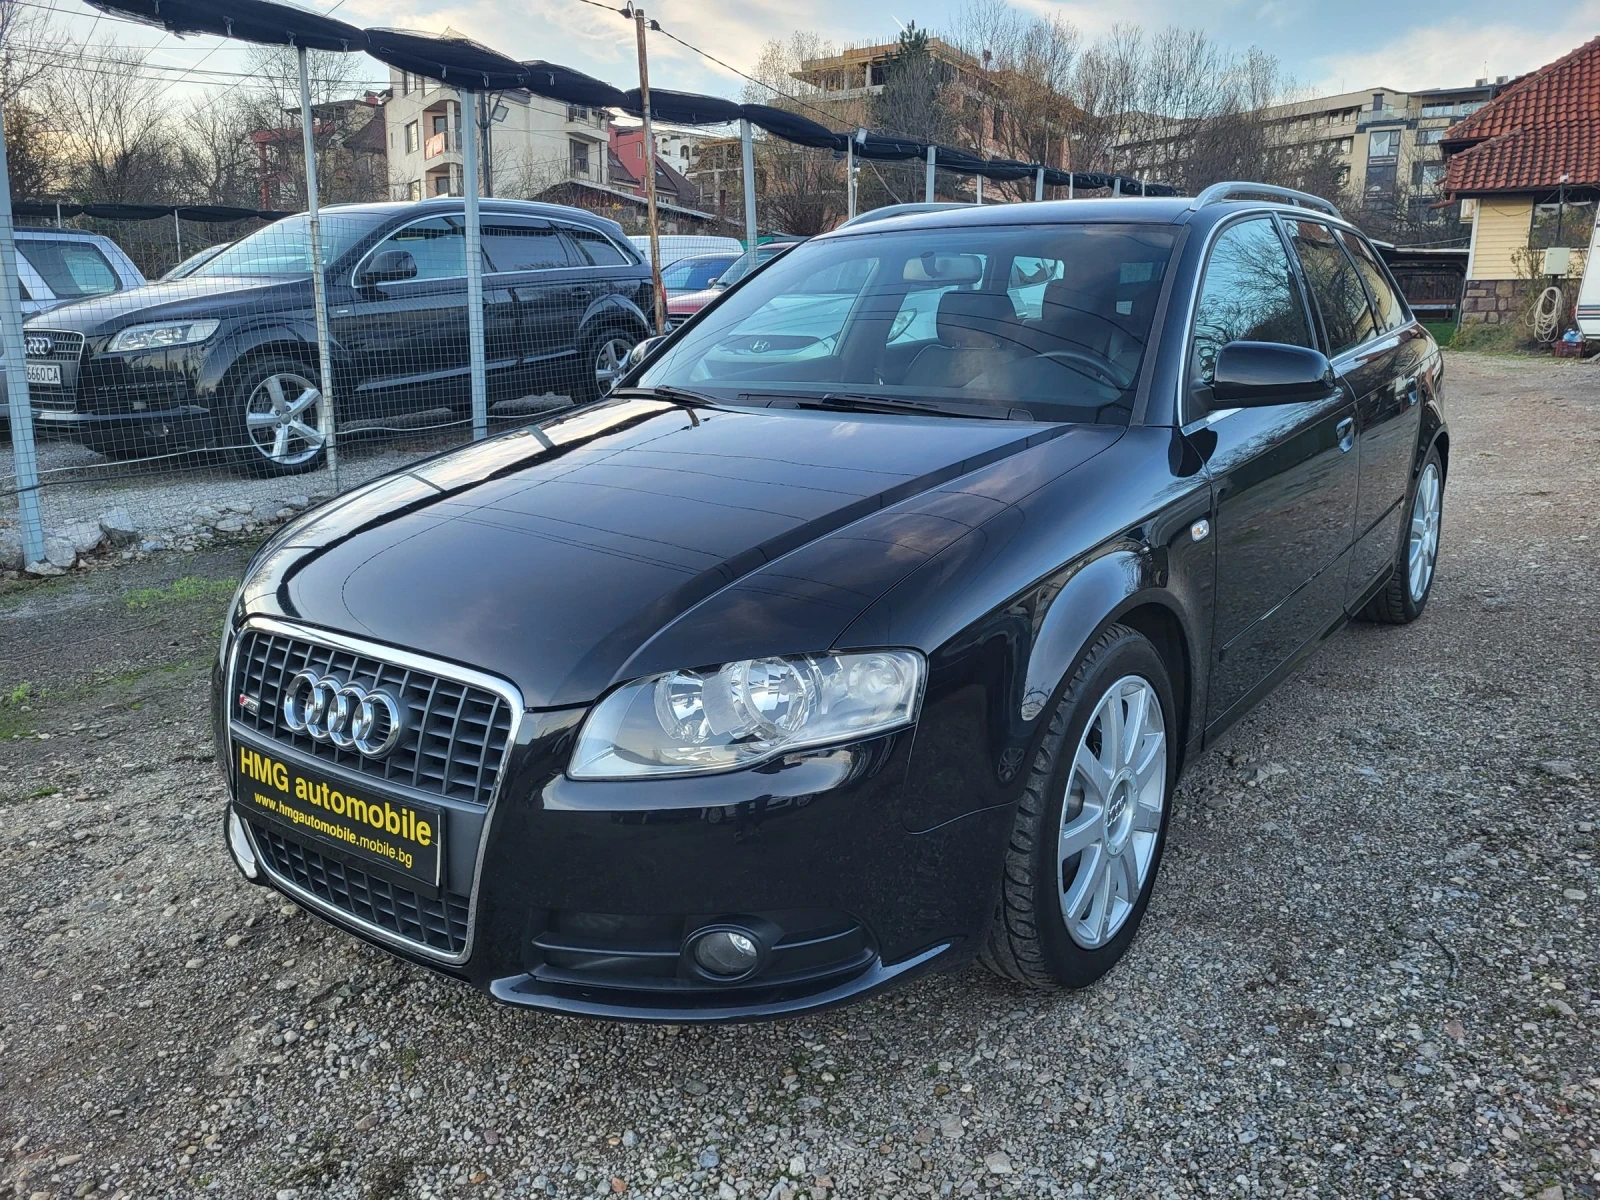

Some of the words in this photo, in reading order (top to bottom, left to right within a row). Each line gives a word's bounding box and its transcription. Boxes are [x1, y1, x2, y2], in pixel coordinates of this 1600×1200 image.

[47, 367, 60, 382] CA
[240, 747, 289, 793] HMG
[295, 777, 432, 846] automobile
[254, 792, 413, 869] www.hmgautomobile.mobile.bg
